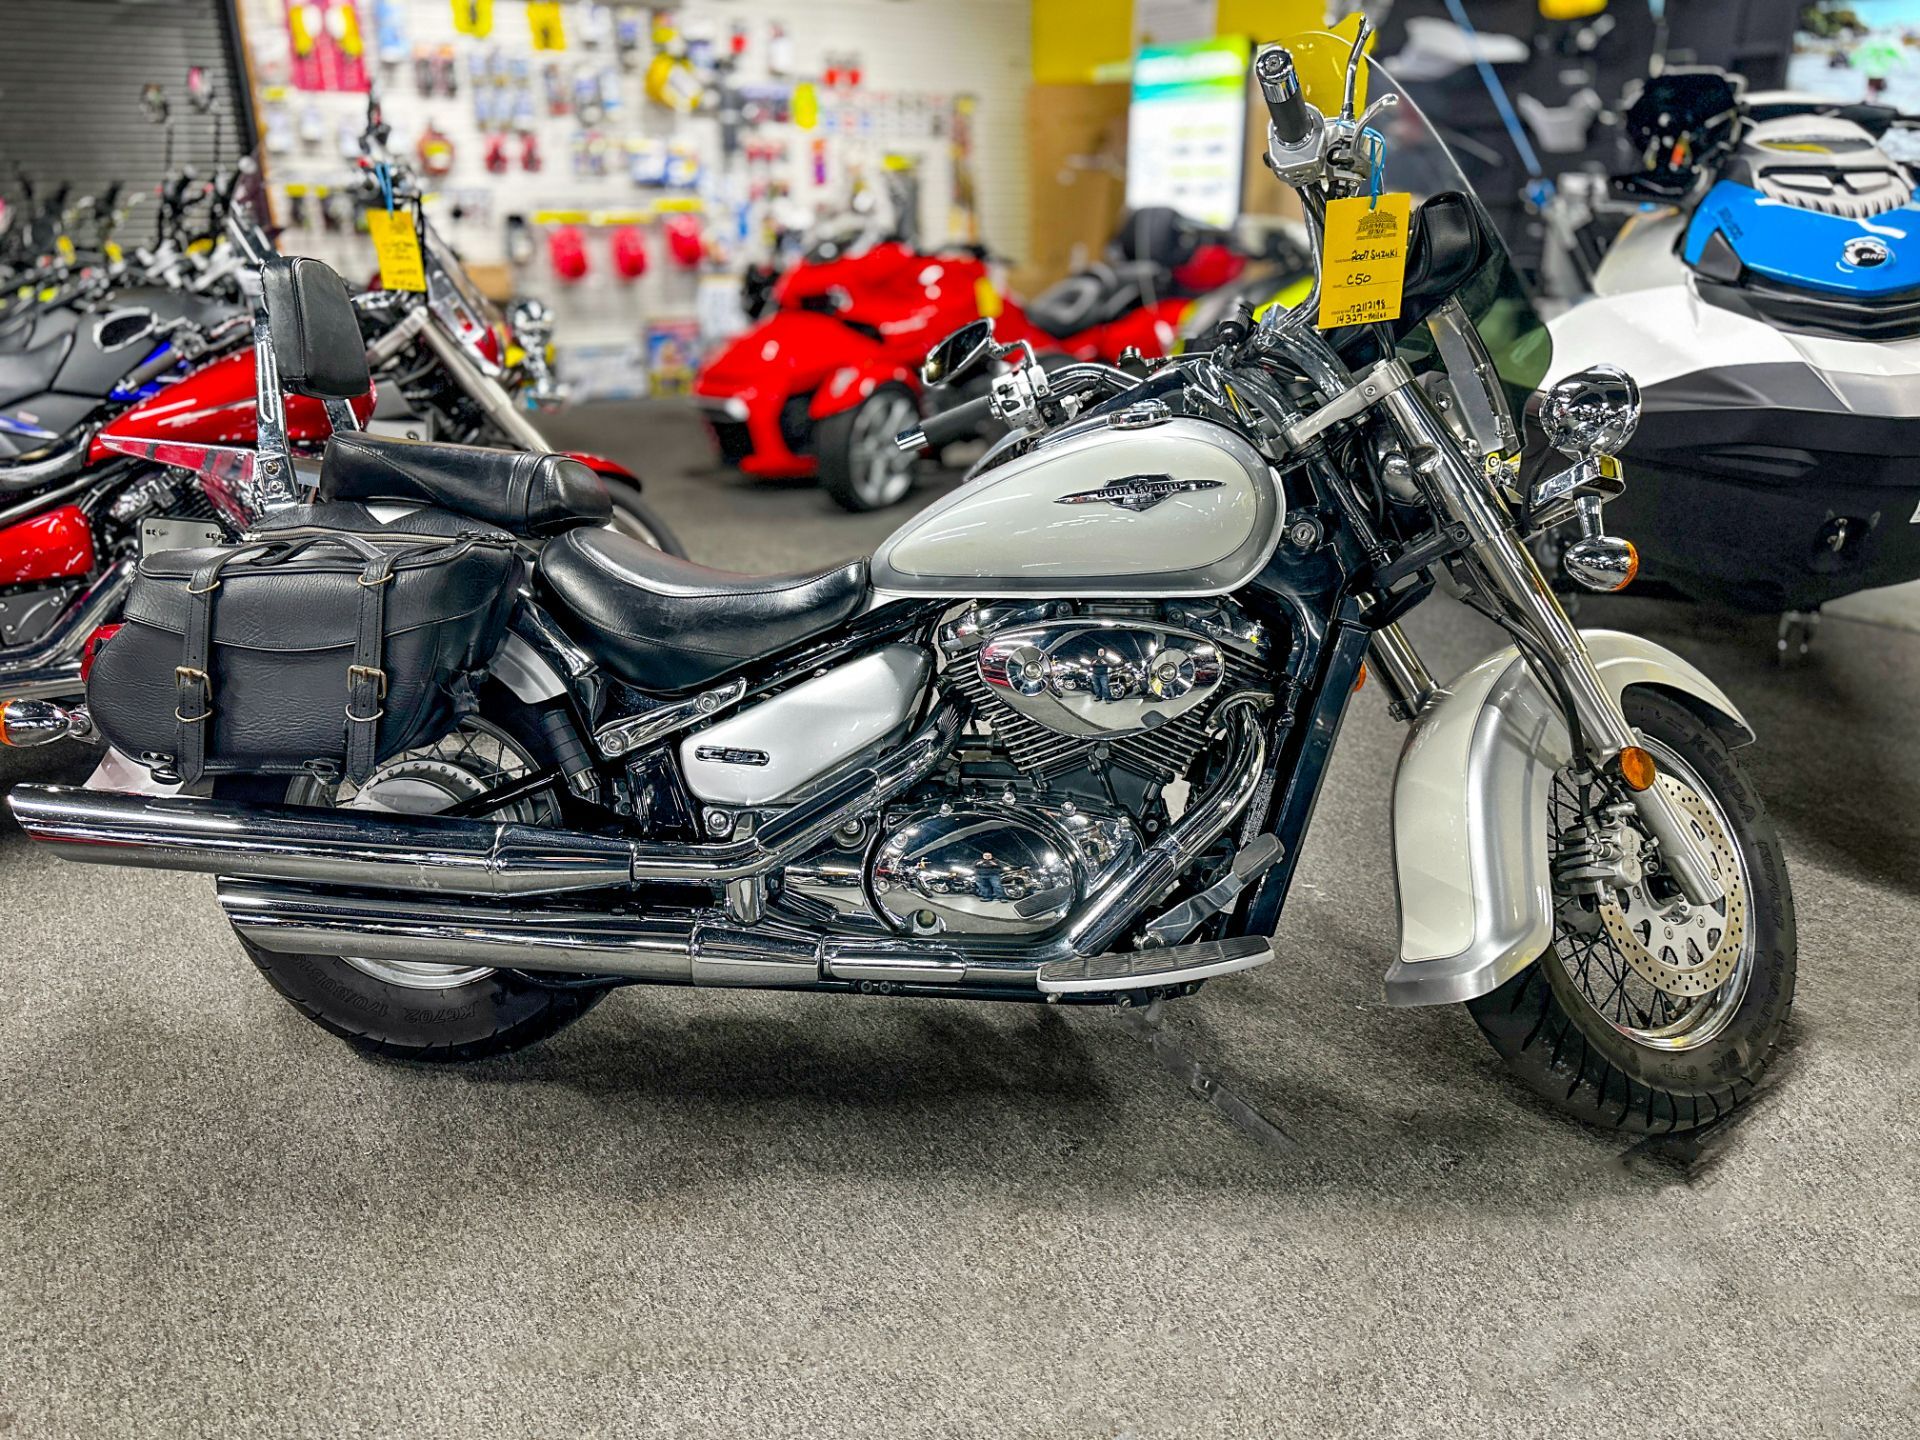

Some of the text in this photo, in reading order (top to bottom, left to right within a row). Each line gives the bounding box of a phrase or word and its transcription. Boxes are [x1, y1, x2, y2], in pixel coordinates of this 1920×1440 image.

[1351, 249, 1369, 261] 2007
[1346, 273, 1371, 285] C50
[1096, 482, 1182, 499] BOULEVARD
[1690, 733, 1757, 823] KENDA
